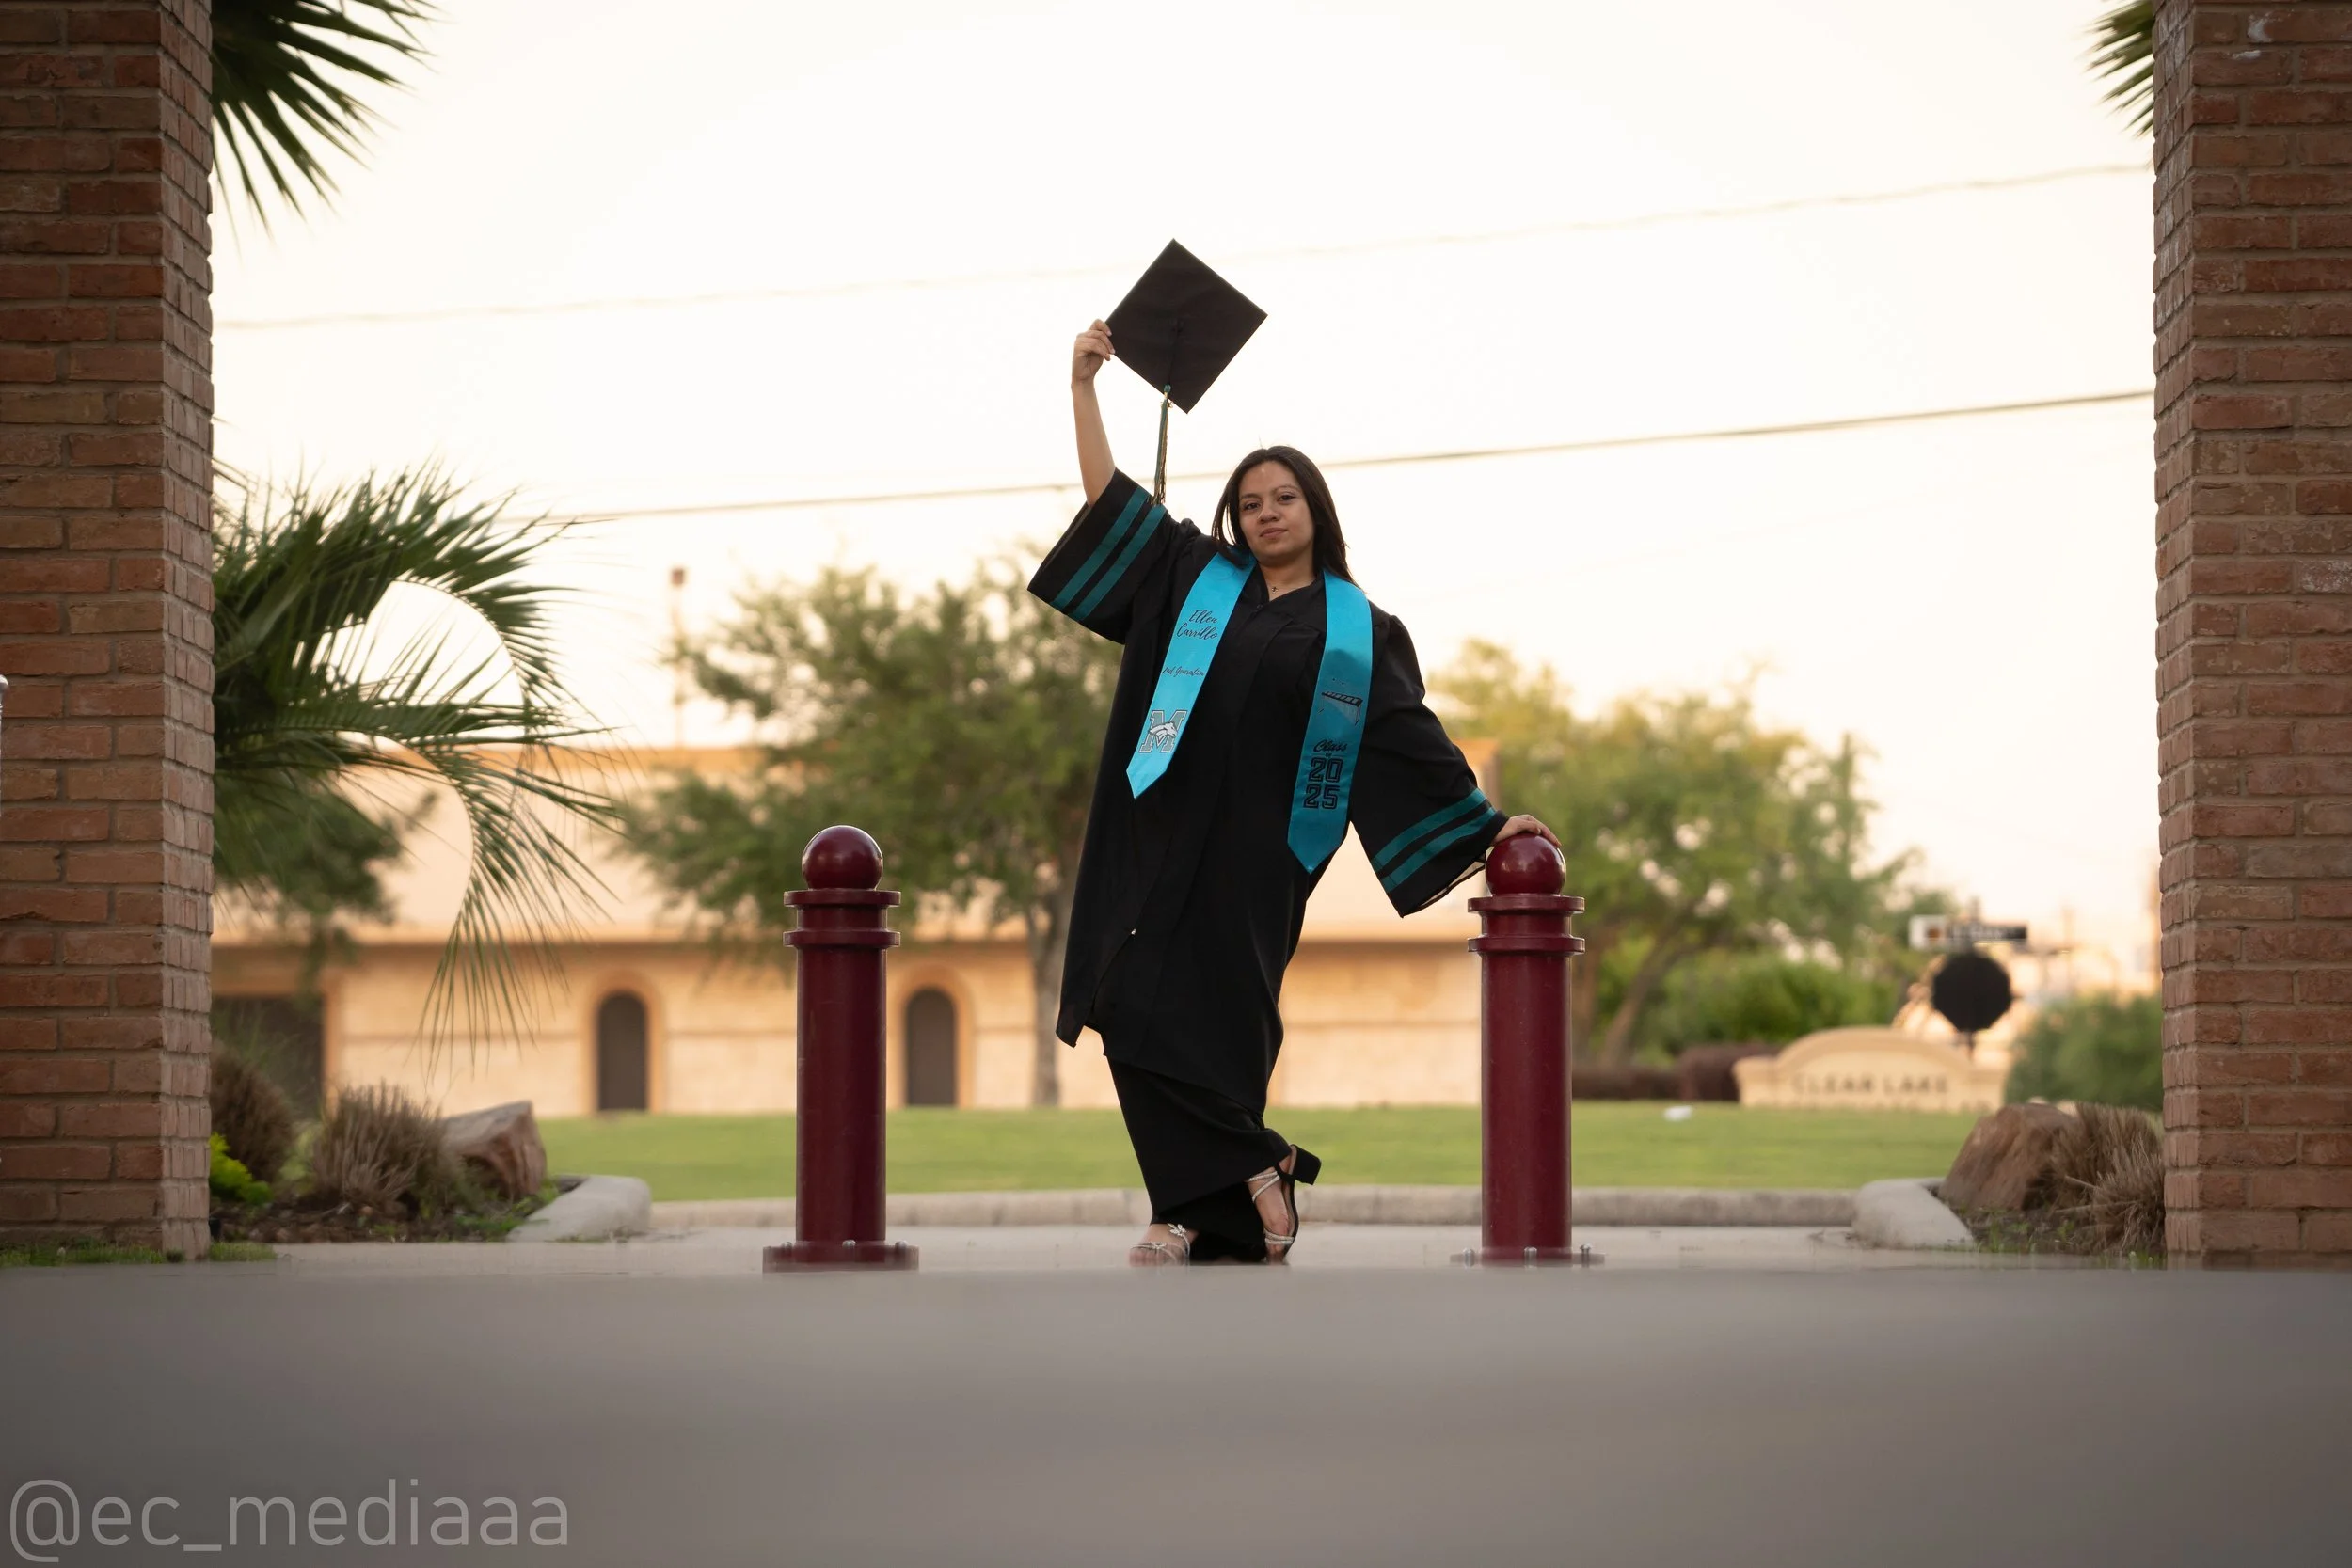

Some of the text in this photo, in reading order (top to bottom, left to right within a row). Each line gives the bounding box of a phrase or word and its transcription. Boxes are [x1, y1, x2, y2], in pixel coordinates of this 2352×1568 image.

[1188, 610, 1217, 624] Ellen
[1176, 622, 1218, 640] Carrillo
[1138, 709, 1187, 752] M
[1313, 739, 1347, 753] Class
[1308, 757, 1343, 783] 20
[1303, 784, 1341, 809] 25
